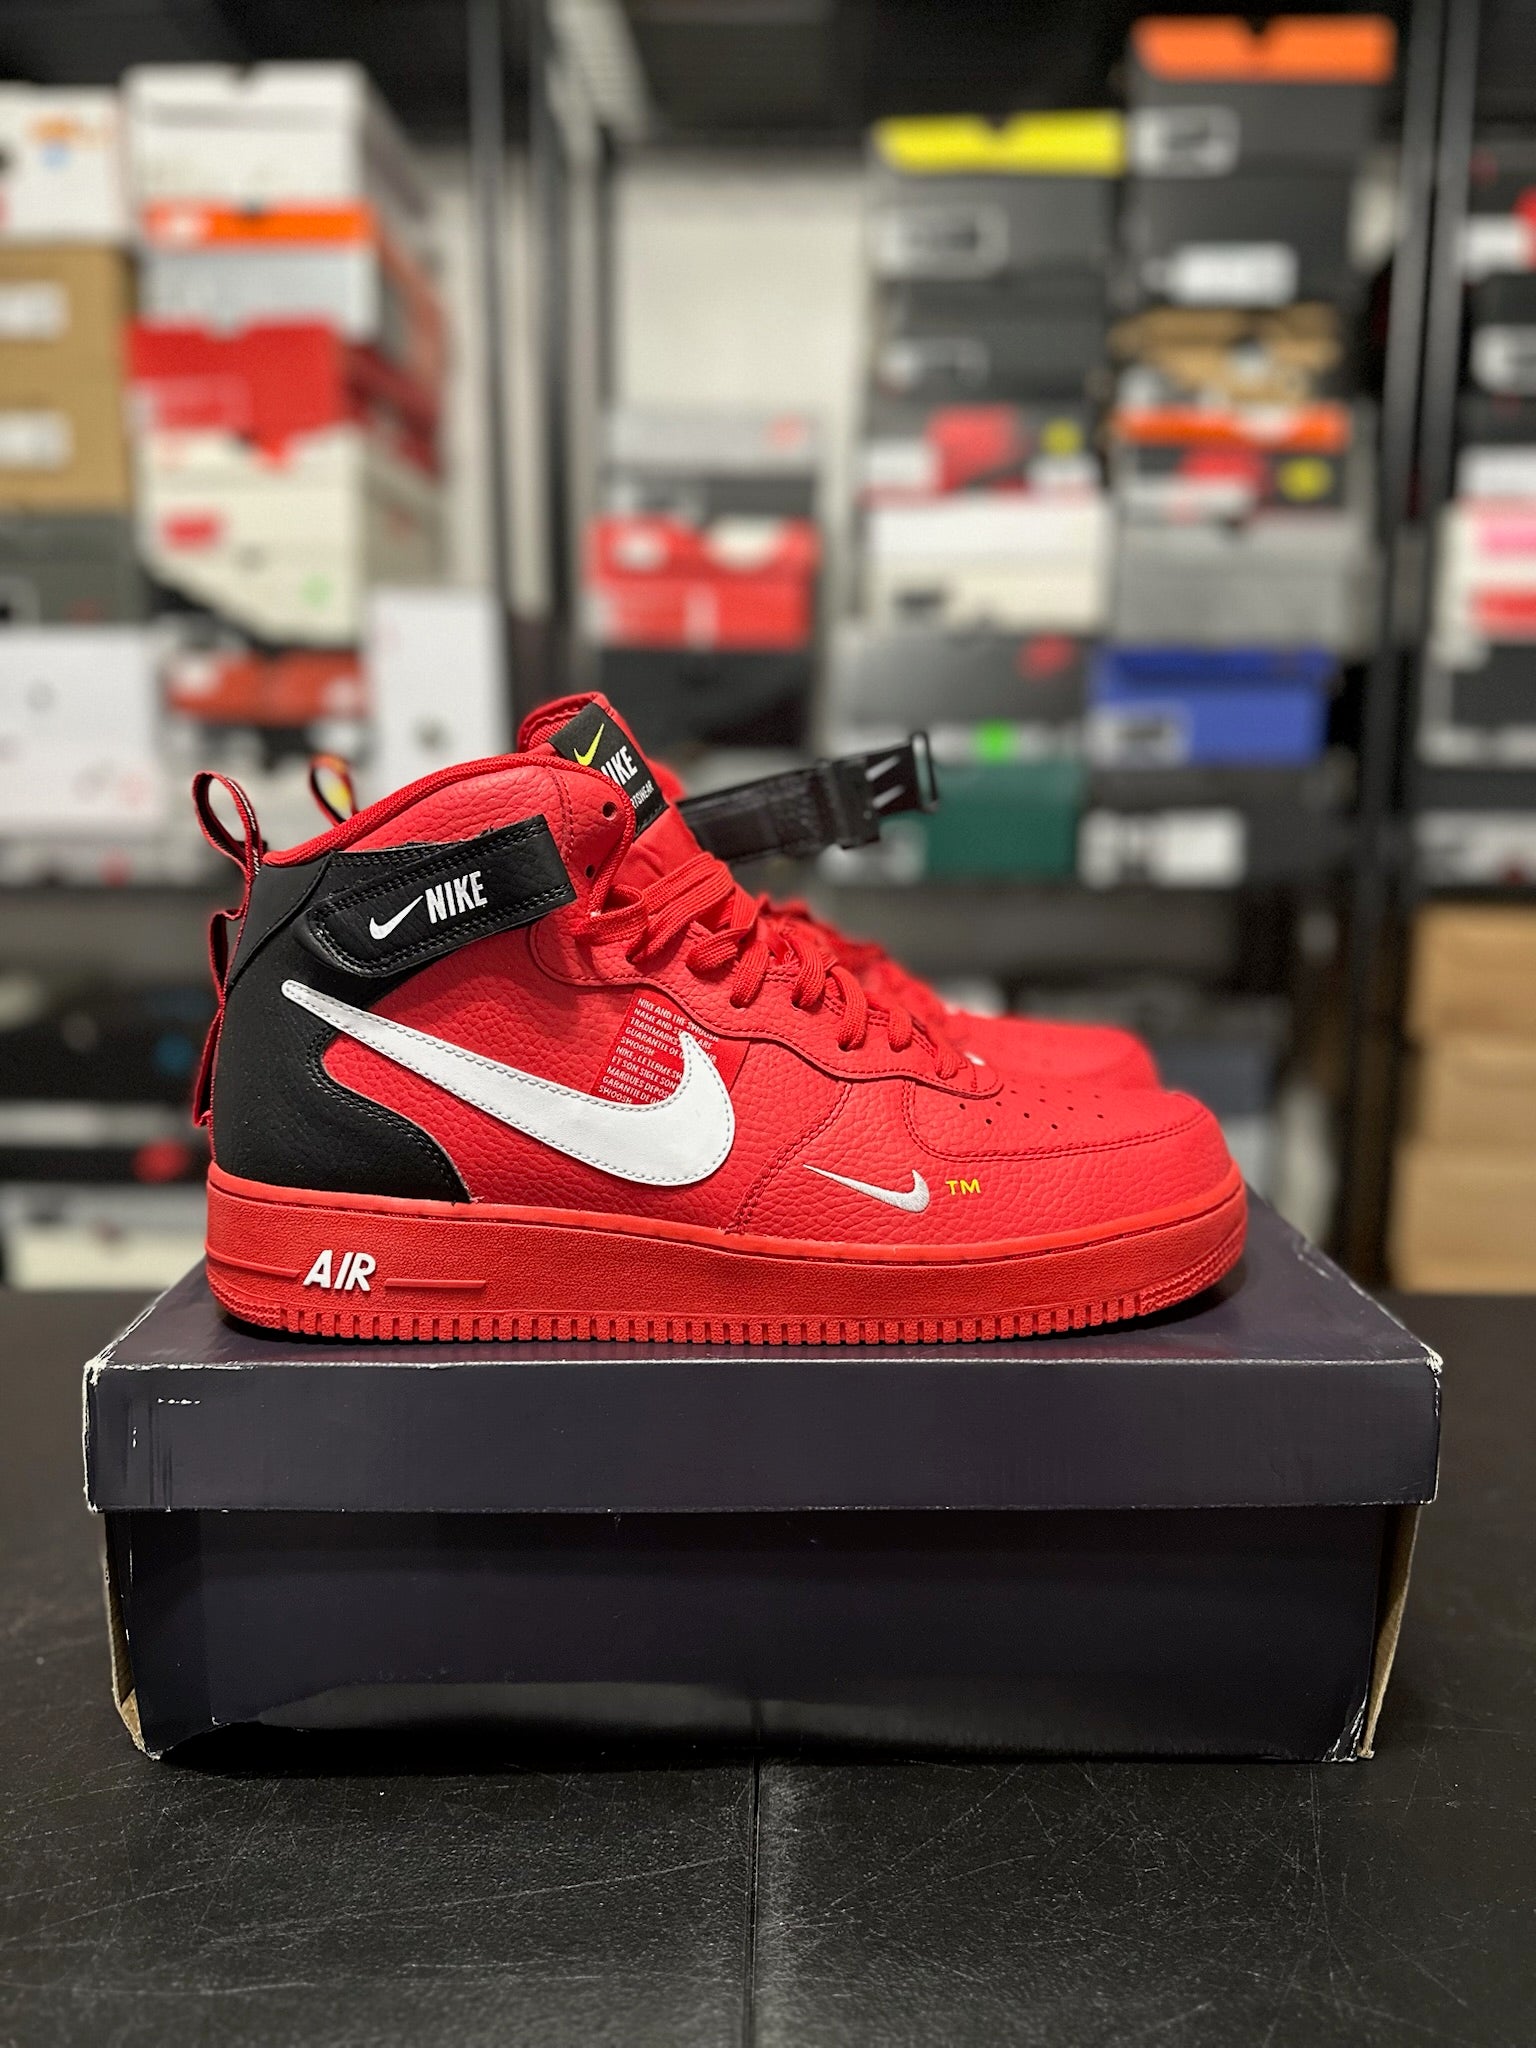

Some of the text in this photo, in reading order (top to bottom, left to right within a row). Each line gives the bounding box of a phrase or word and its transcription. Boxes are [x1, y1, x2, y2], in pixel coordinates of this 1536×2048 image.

[425, 870, 488, 924] NIKE
[637, 998, 654, 1011] NIKE
[655, 1006, 672, 1019] AND
[672, 1014, 686, 1026] THE
[625, 1026, 669, 1052] GUARANTEE
[669, 1047, 679, 1056] OF
[630, 1016, 679, 1046] TRADEMARKS
[634, 1008, 656, 1024] NAME
[656, 1018, 673, 1031] AND
[697, 1038, 713, 1050] ARE
[620, 1036, 655, 1056] SWOOSH
[606, 1065, 645, 1088] MARQUES
[611, 1055, 623, 1065] ET
[622, 1060, 639, 1073] SON
[639, 1067, 660, 1082] SIGLE
[637, 1055, 648, 1065] LE
[646, 1059, 673, 1076] TERME
[598, 1085, 633, 1104] SWOOSH
[602, 1075, 641, 1098] GARANTIE
[640, 1092, 651, 1102] DE
[945, 1178, 981, 1196] TM
[302, 1249, 377, 1292] AIR
